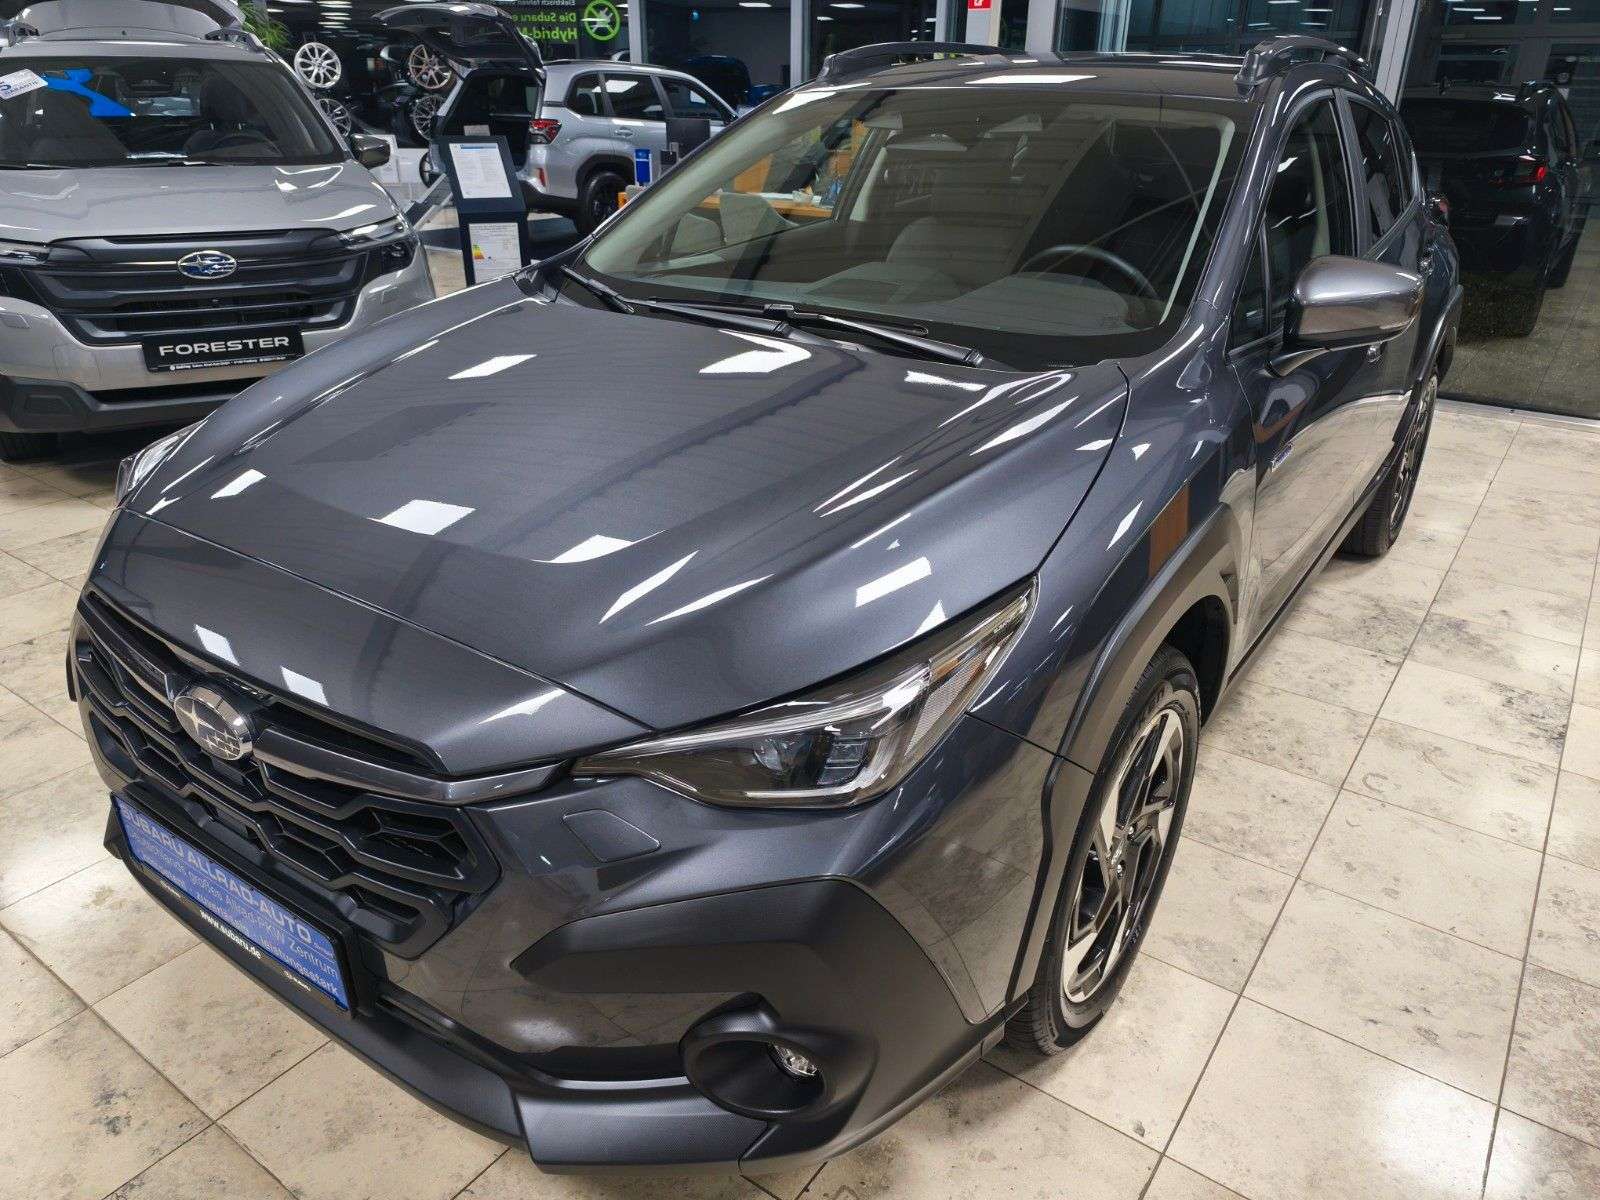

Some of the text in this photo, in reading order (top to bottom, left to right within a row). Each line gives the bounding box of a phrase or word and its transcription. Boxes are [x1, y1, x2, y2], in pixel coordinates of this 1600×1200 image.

[159, 336, 290, 356] FORESTER
[119, 802, 184, 858] SUBARU
[187, 850, 312, 944] ALLRAD-AUTO
[200, 909, 261, 959] www.subaru.de
[287, 936, 338, 979] Zentrum
